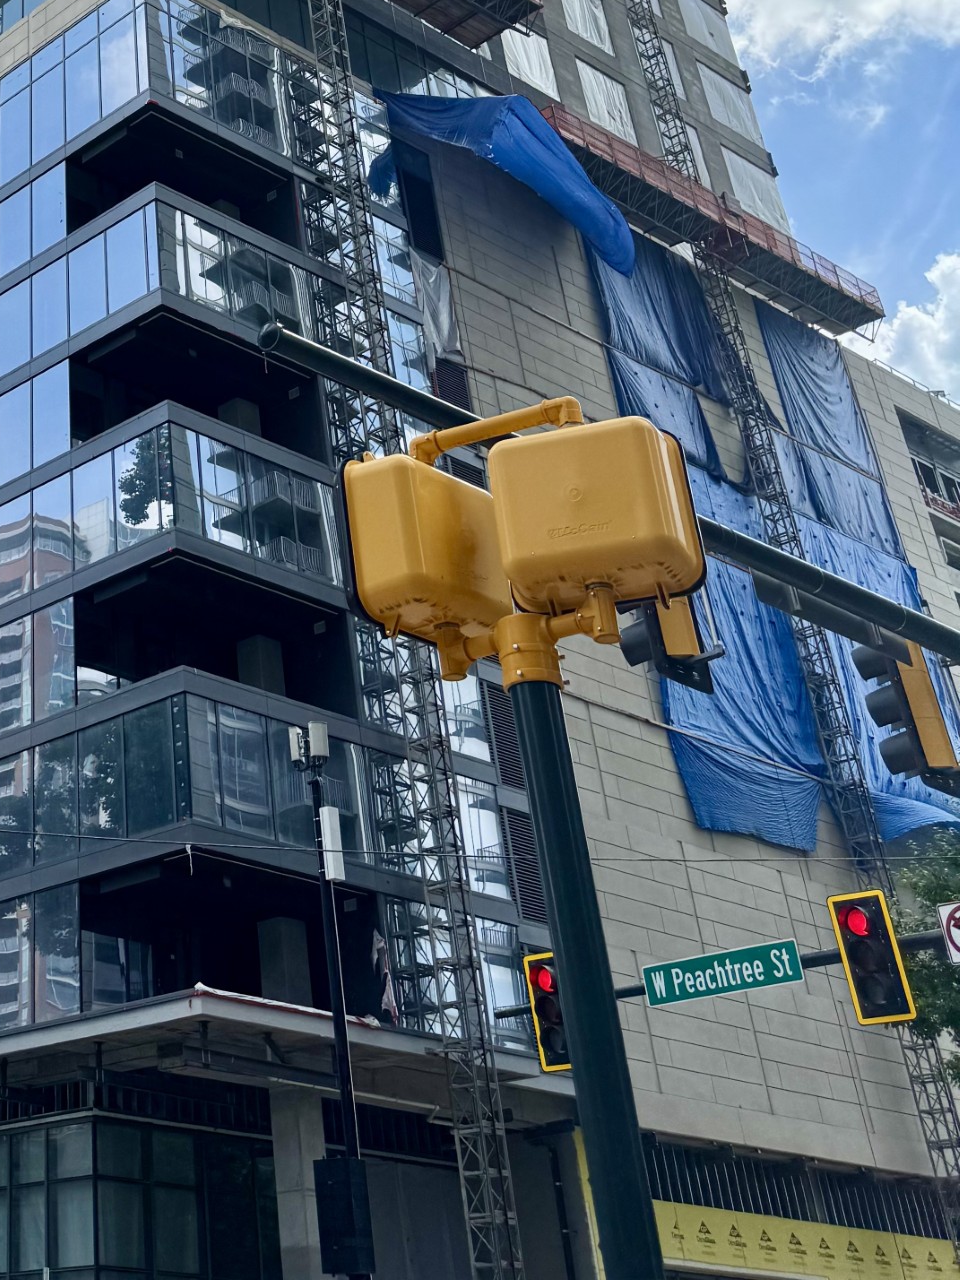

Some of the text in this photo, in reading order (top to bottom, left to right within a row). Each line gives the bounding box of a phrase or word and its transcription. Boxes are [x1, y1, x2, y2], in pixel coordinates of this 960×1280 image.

[651, 947, 793, 999] W Peachtree St
